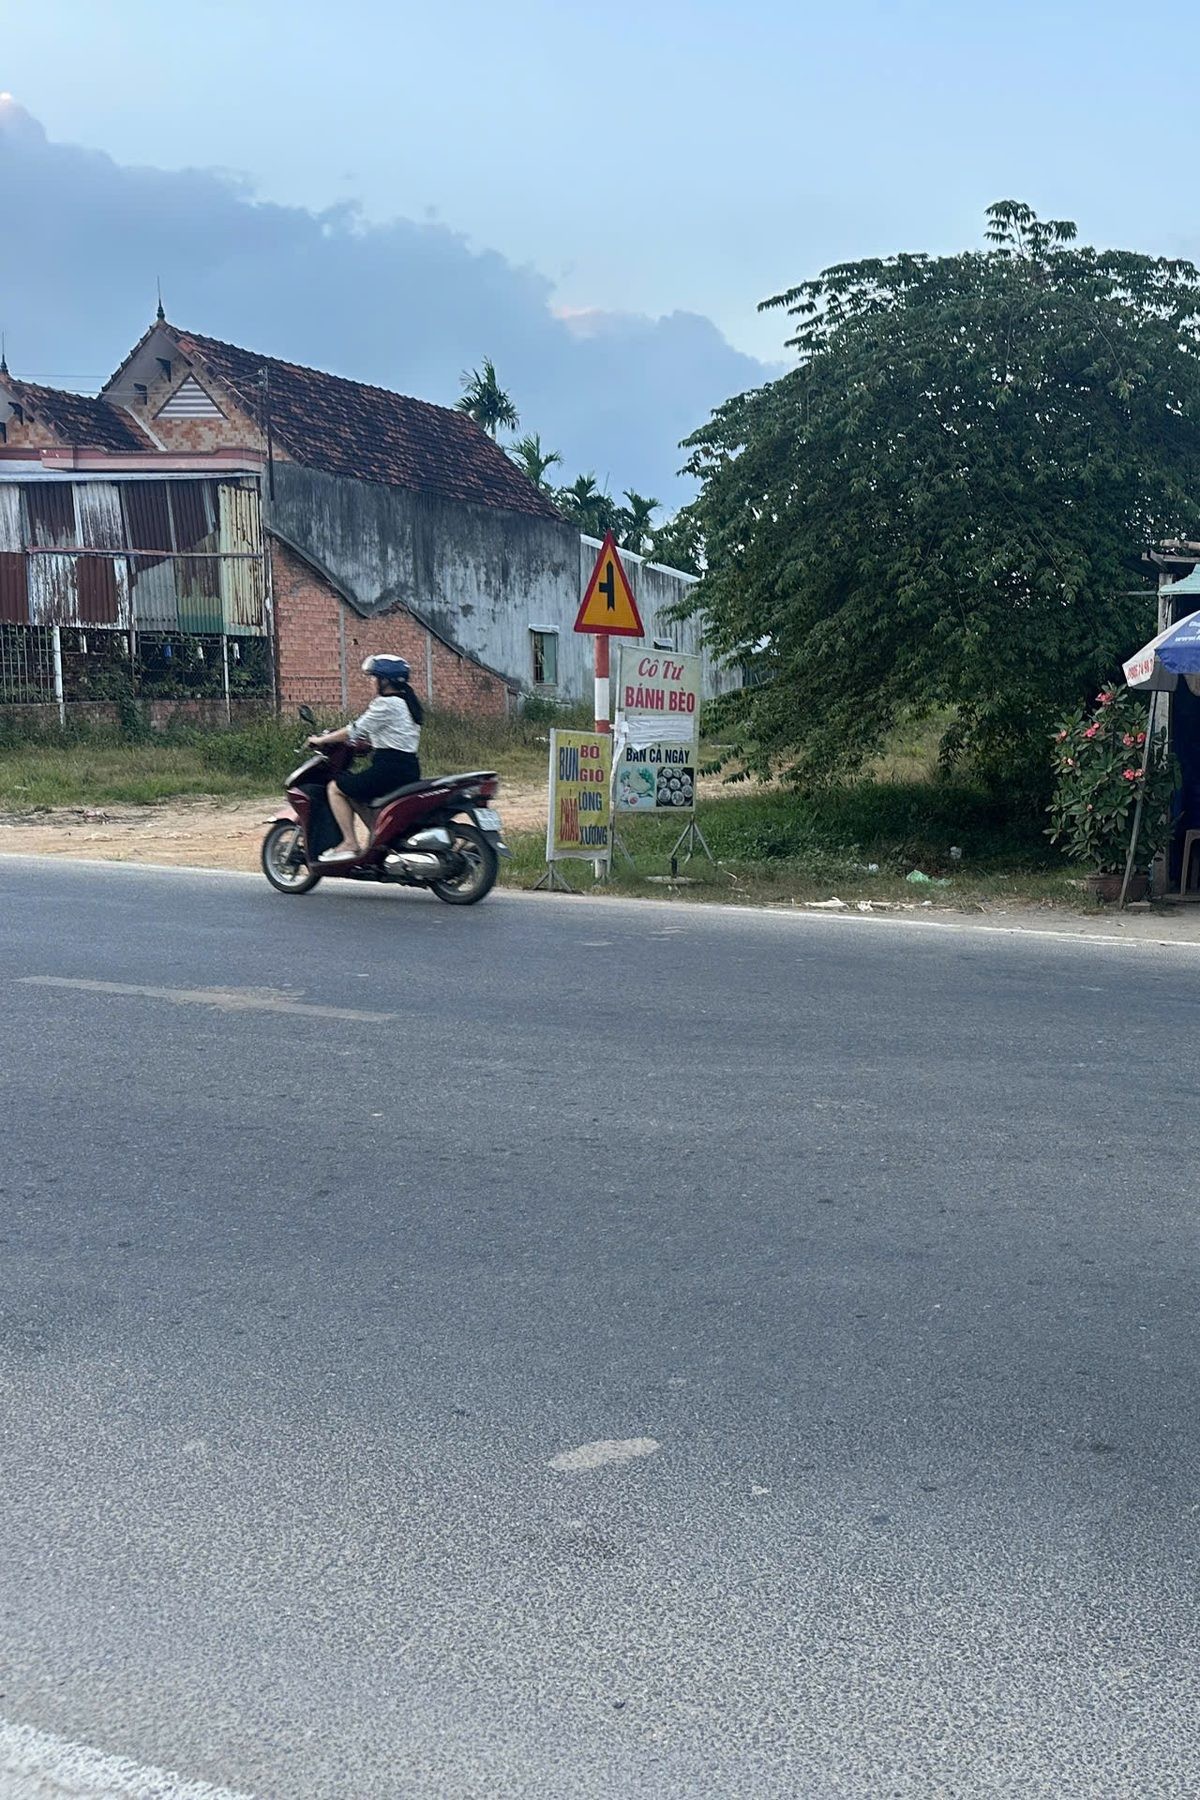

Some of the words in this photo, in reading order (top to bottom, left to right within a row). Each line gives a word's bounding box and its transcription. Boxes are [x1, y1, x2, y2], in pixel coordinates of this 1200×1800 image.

[638, 657, 659, 678] Cô
[662, 660, 684, 680] Tư
[625, 683, 665, 710] BÁNH
[668, 687, 695, 713] BÈO
[559, 739, 579, 782] BÚN
[580, 742, 600, 759] BÒ
[649, 744, 662, 763] CẢ
[665, 747, 690, 764] NGÀY
[580, 765, 604, 783] GIÒ
[578, 786, 602, 811] LÒNG
